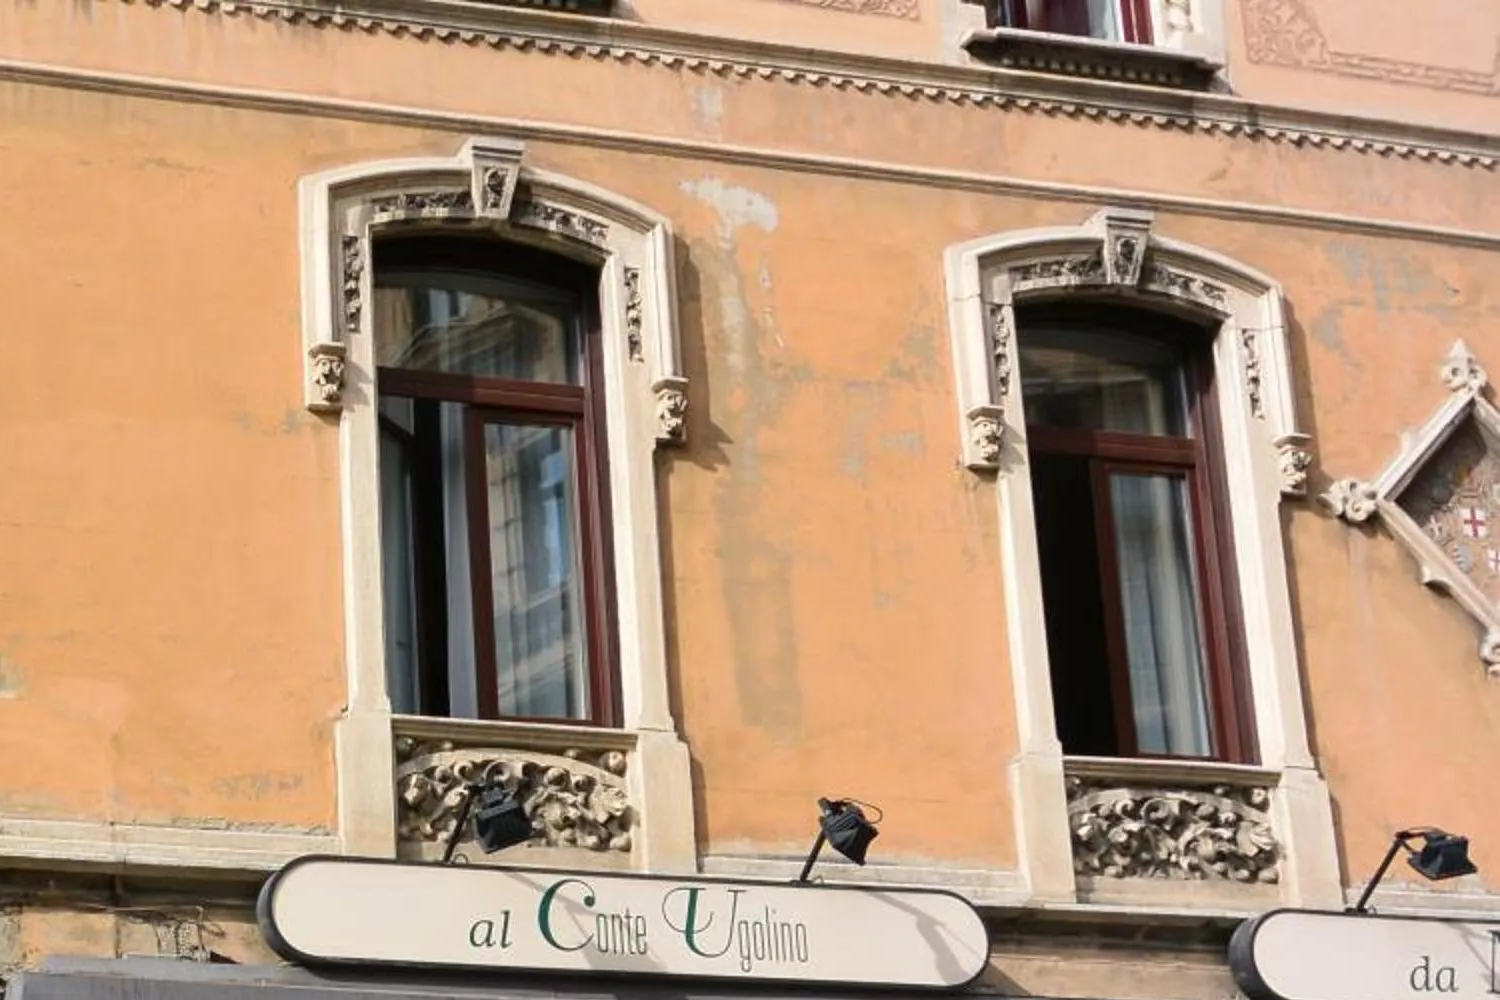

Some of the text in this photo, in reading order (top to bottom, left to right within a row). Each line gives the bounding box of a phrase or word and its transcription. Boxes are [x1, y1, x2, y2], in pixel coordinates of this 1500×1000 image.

[469, 878, 809, 973] al Conte Ugolino
[1409, 955, 1459, 993] da
